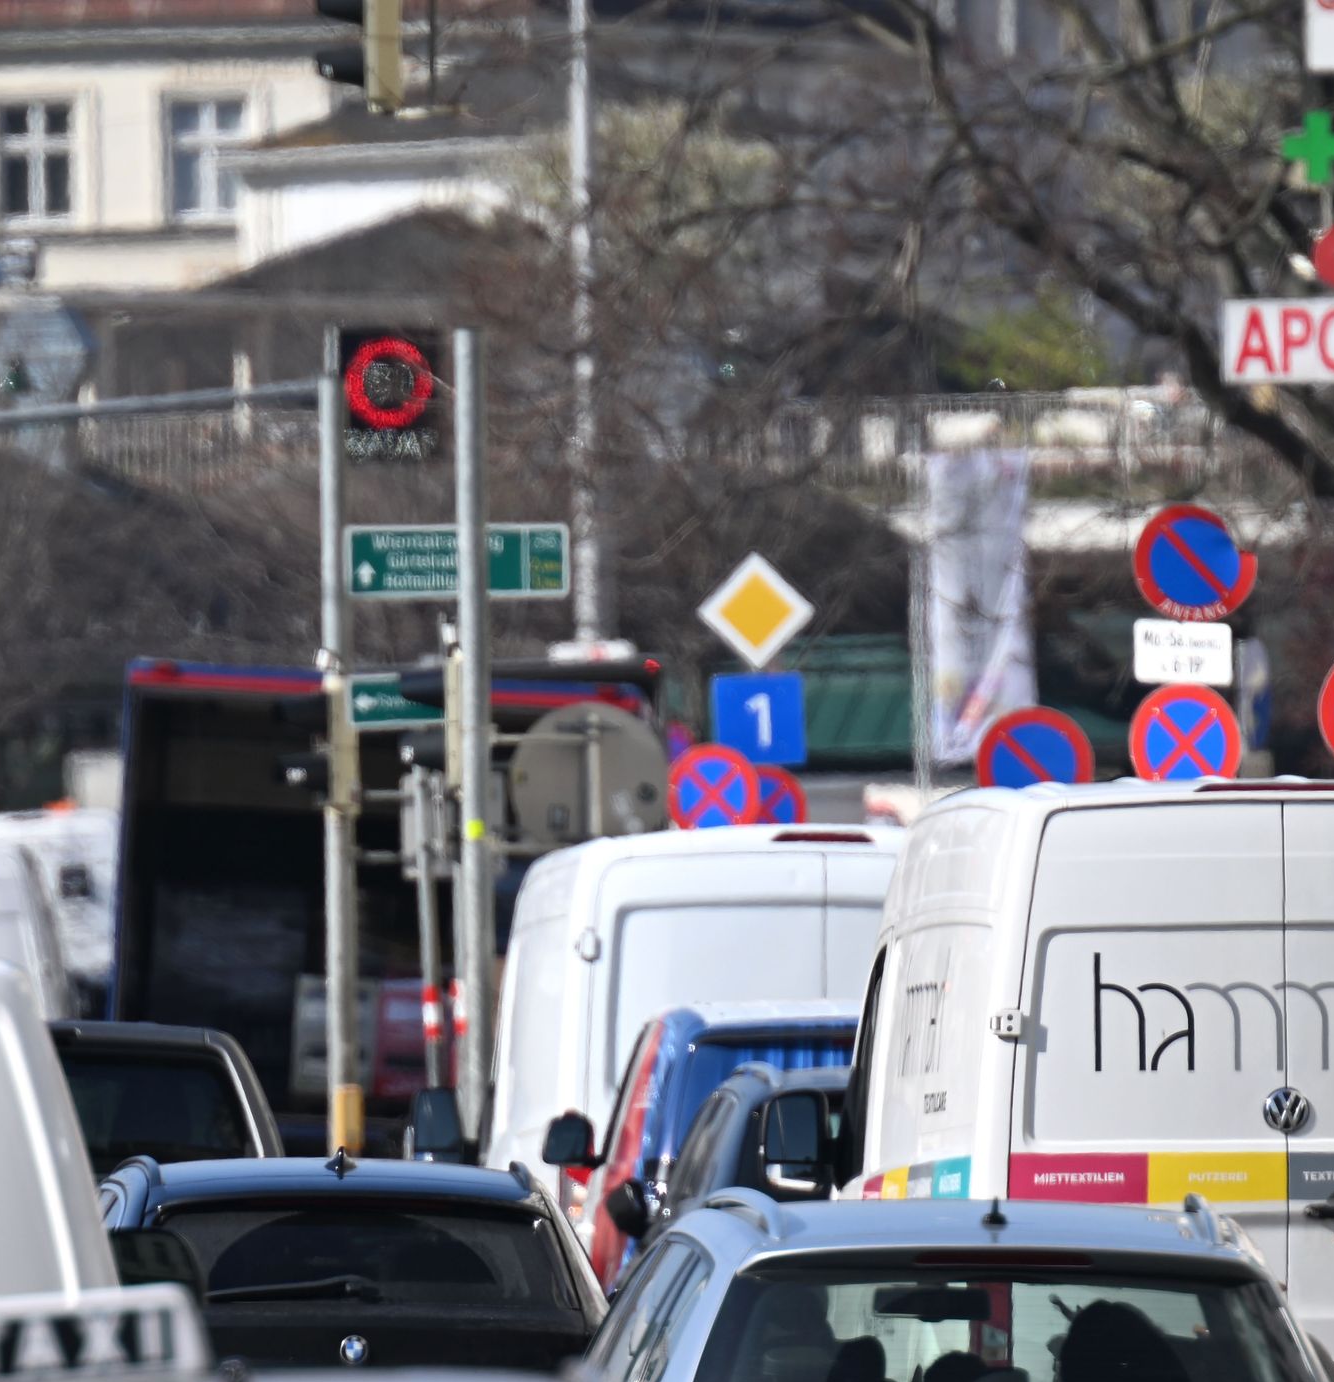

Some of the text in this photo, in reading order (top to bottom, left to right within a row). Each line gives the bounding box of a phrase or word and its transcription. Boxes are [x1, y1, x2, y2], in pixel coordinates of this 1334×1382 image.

[1159, 597, 1228, 619] ANFANG
[745, 691, 773, 749] 1
[1034, 1171, 1125, 1186] MIETTEXTILIEN
[1188, 1171, 1249, 1183] PUTZEREI
